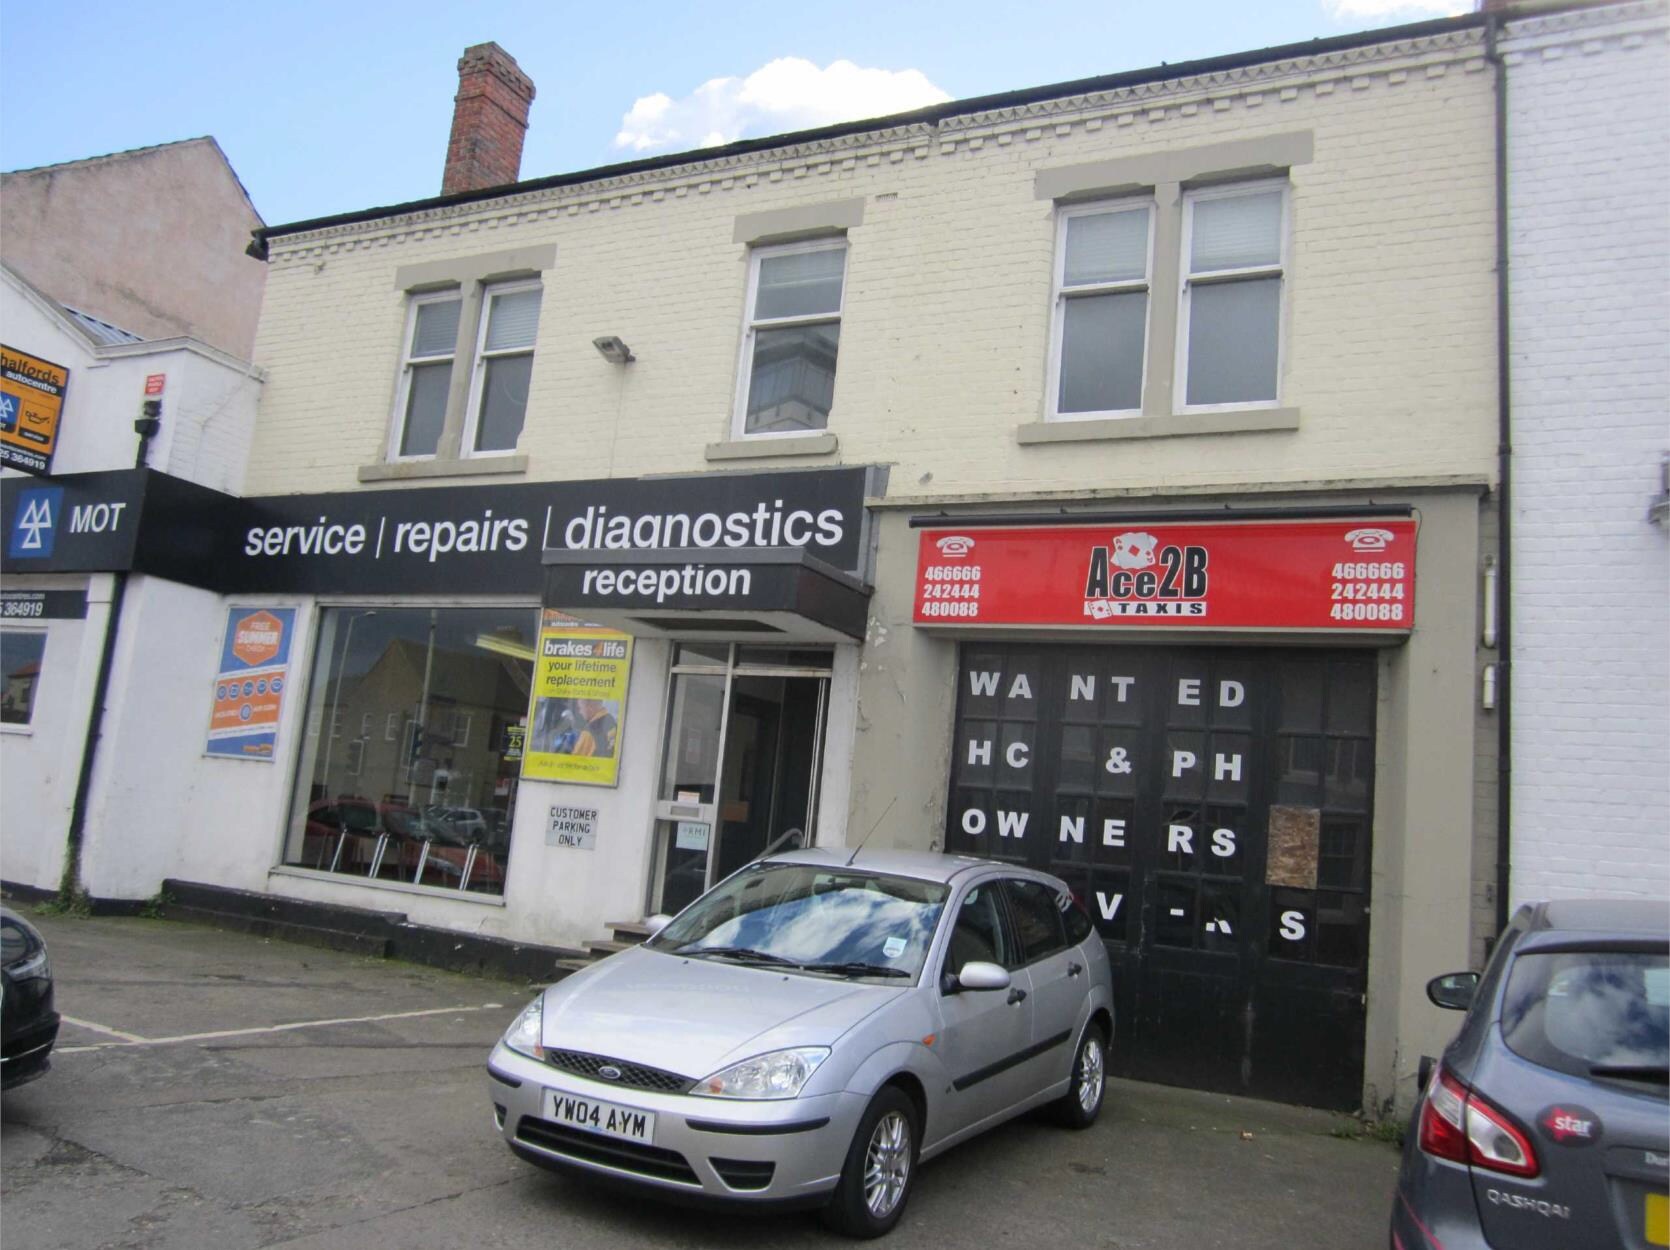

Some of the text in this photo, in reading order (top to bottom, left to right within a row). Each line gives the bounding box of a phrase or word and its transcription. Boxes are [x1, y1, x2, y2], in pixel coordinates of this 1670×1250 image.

[1, 352, 60, 386] halfords
[6, 371, 57, 394] autocentre
[69, 502, 127, 533] MOT
[245, 499, 844, 562] service repairs diagnostics
[924, 566, 981, 581] 466666
[1085, 545, 1208, 599] Ace2B
[1332, 562, 1404, 579] 466666
[582, 565, 751, 602] reception
[923, 583, 980, 599] 242444
[1331, 583, 1404, 600] 242444
[4, 602, 43, 617] 364919
[921, 602, 978, 617] 480088
[1118, 602, 1203, 614] TAXIS
[1330, 602, 1403, 620] 480088
[544, 640, 625, 657] brakes4life
[548, 660, 617, 673] your lifetime
[546, 674, 616, 687] replacement
[1105, 747, 1132, 774] &
[550, 807, 597, 820] CUSTOMER
[552, 820, 591, 834] PARKING
[558, 834, 582, 847] ONLY
[553, 1095, 646, 1138] YW04 AYM
[1554, 1115, 1593, 1134] star
[1487, 1188, 1570, 1217] QASHQAI
